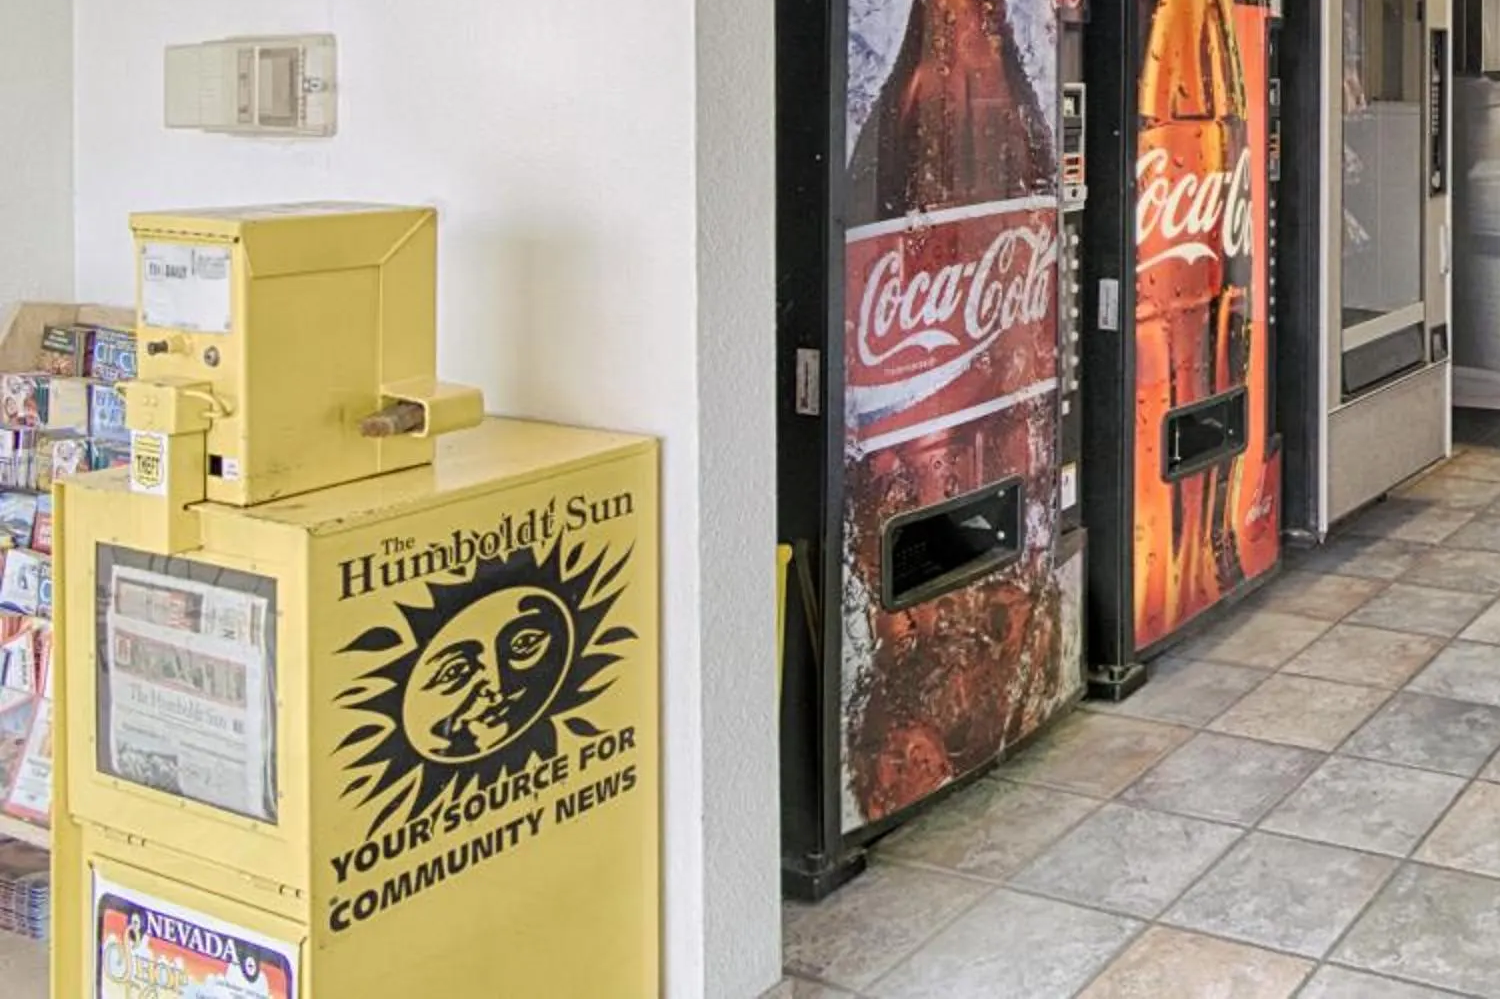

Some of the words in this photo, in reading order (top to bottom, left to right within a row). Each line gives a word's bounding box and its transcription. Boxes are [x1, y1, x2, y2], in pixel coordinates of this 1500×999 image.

[858, 225, 1058, 367] Coca-Cola
[337, 507, 556, 602] Humboldt
[565, 491, 635, 532] Sun
[380, 536, 416, 557] The
[328, 807, 545, 934] COMMUNITY
[554, 764, 638, 825] NEWS
[330, 816, 432, 884] YOUR
[442, 754, 569, 833] SOURCE
[578, 725, 636, 772] FOR
[146, 911, 241, 966] NEVADA
